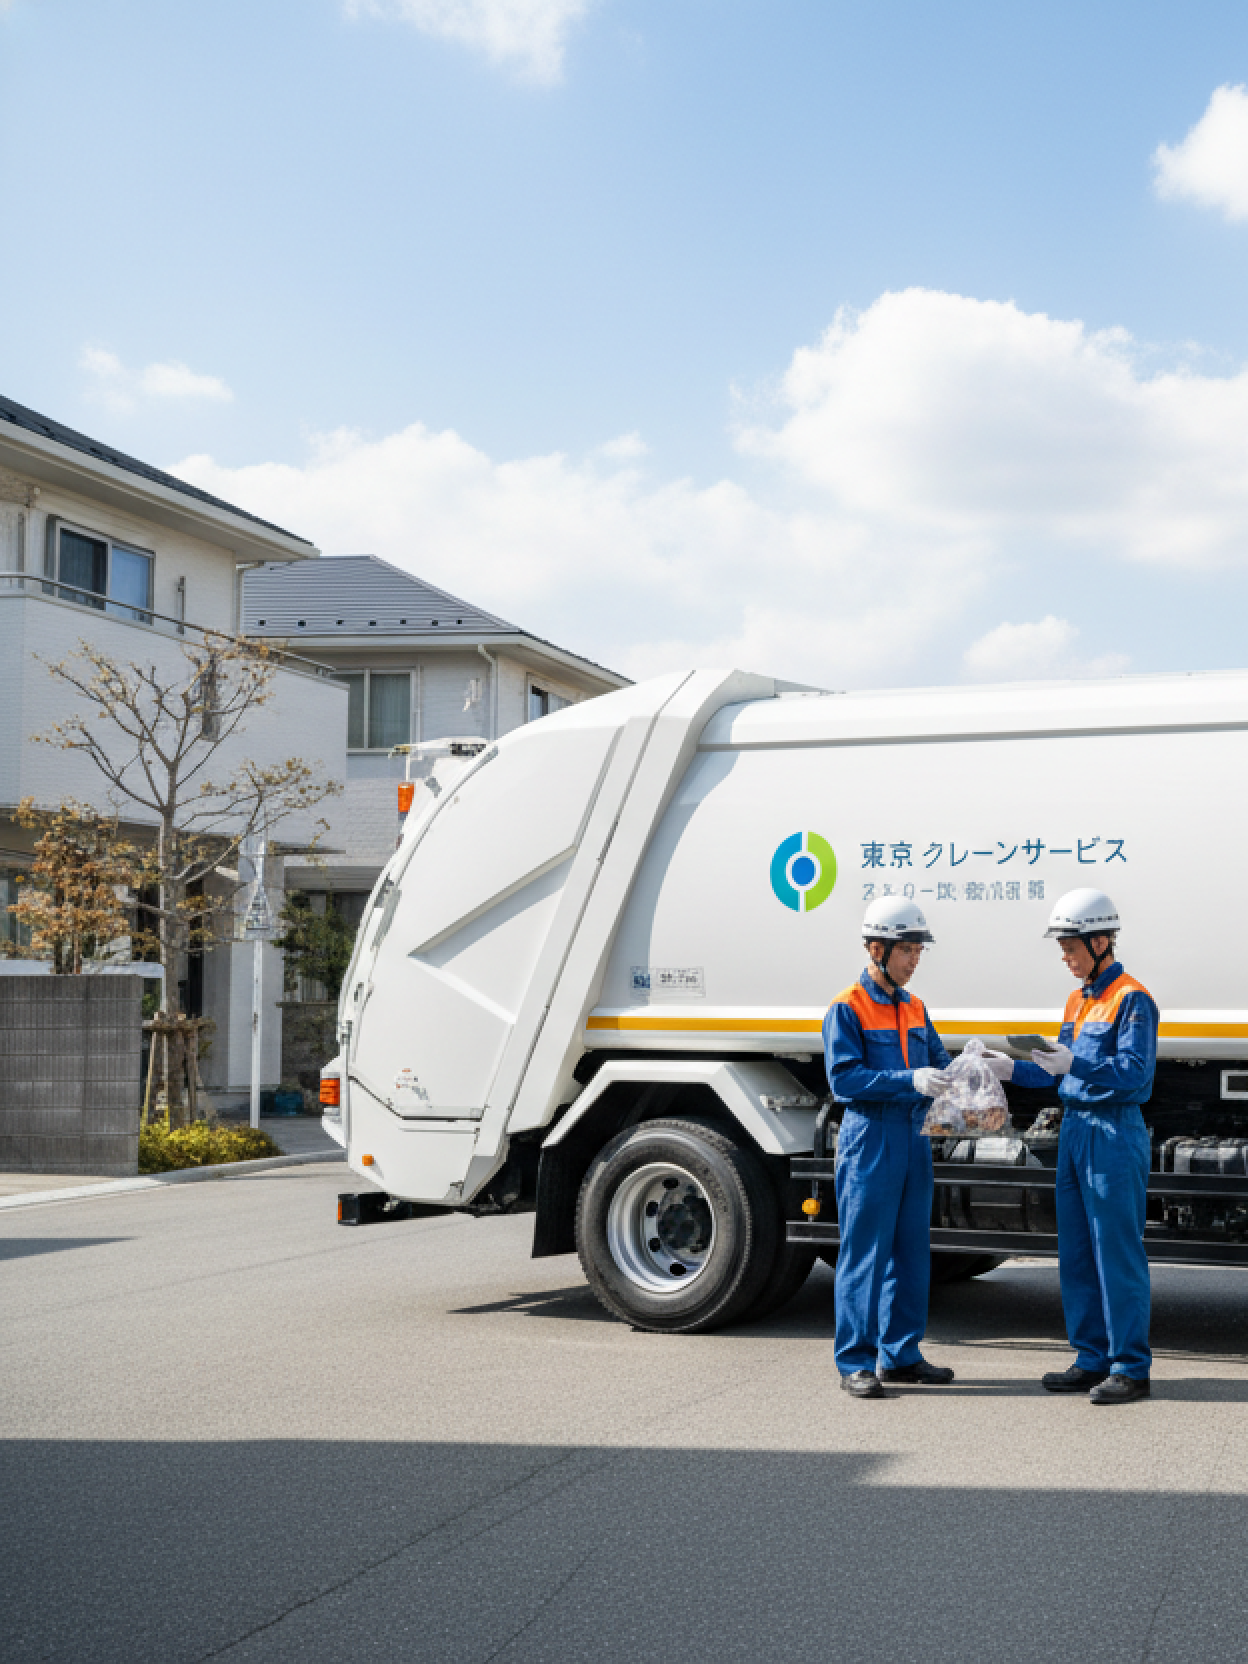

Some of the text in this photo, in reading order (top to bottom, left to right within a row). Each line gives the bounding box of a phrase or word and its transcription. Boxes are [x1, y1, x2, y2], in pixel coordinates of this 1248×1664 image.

[860, 837, 1127, 869] 東京 クレーンサービス
